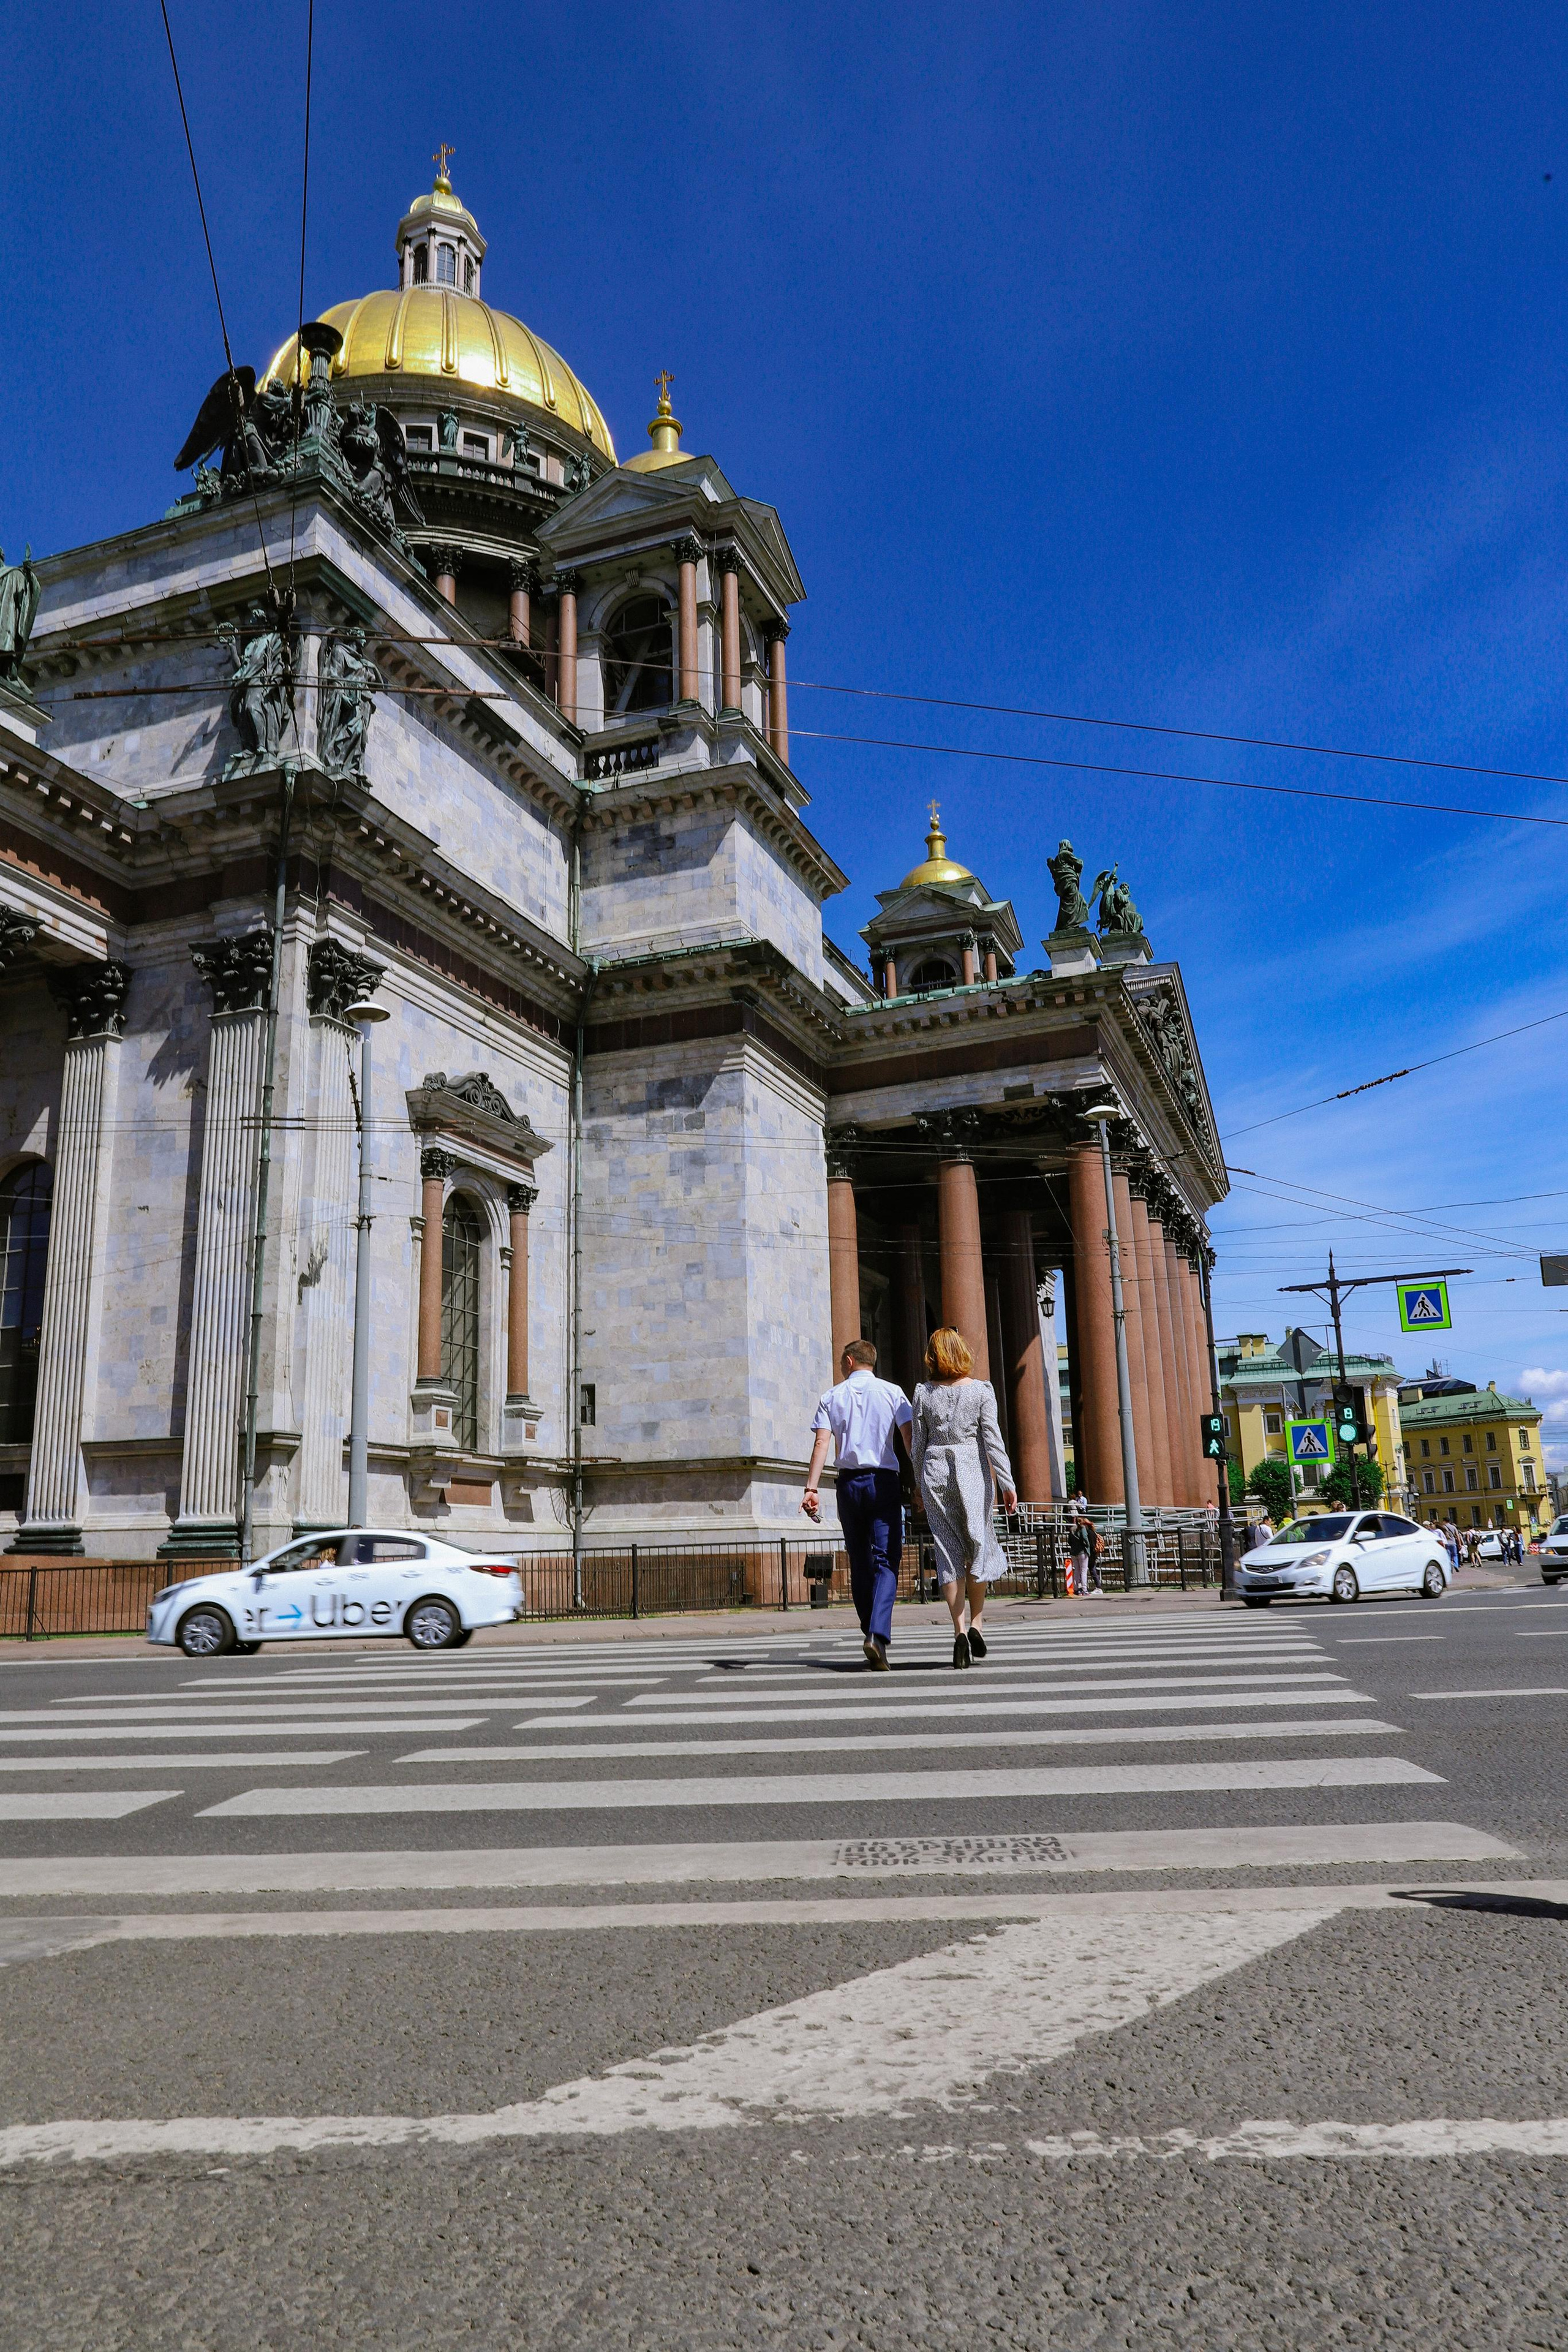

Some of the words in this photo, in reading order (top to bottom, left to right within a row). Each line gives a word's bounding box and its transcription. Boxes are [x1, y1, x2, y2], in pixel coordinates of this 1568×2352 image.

[1343, 1408, 1353, 1419] 19
[1210, 1418, 1221, 1431] 19
[310, 1593, 410, 1627] Uber
[900, 1841, 1061, 1851] КРЫШАМ
[842, 1853, 1068, 1866] TOUR-START.RU
